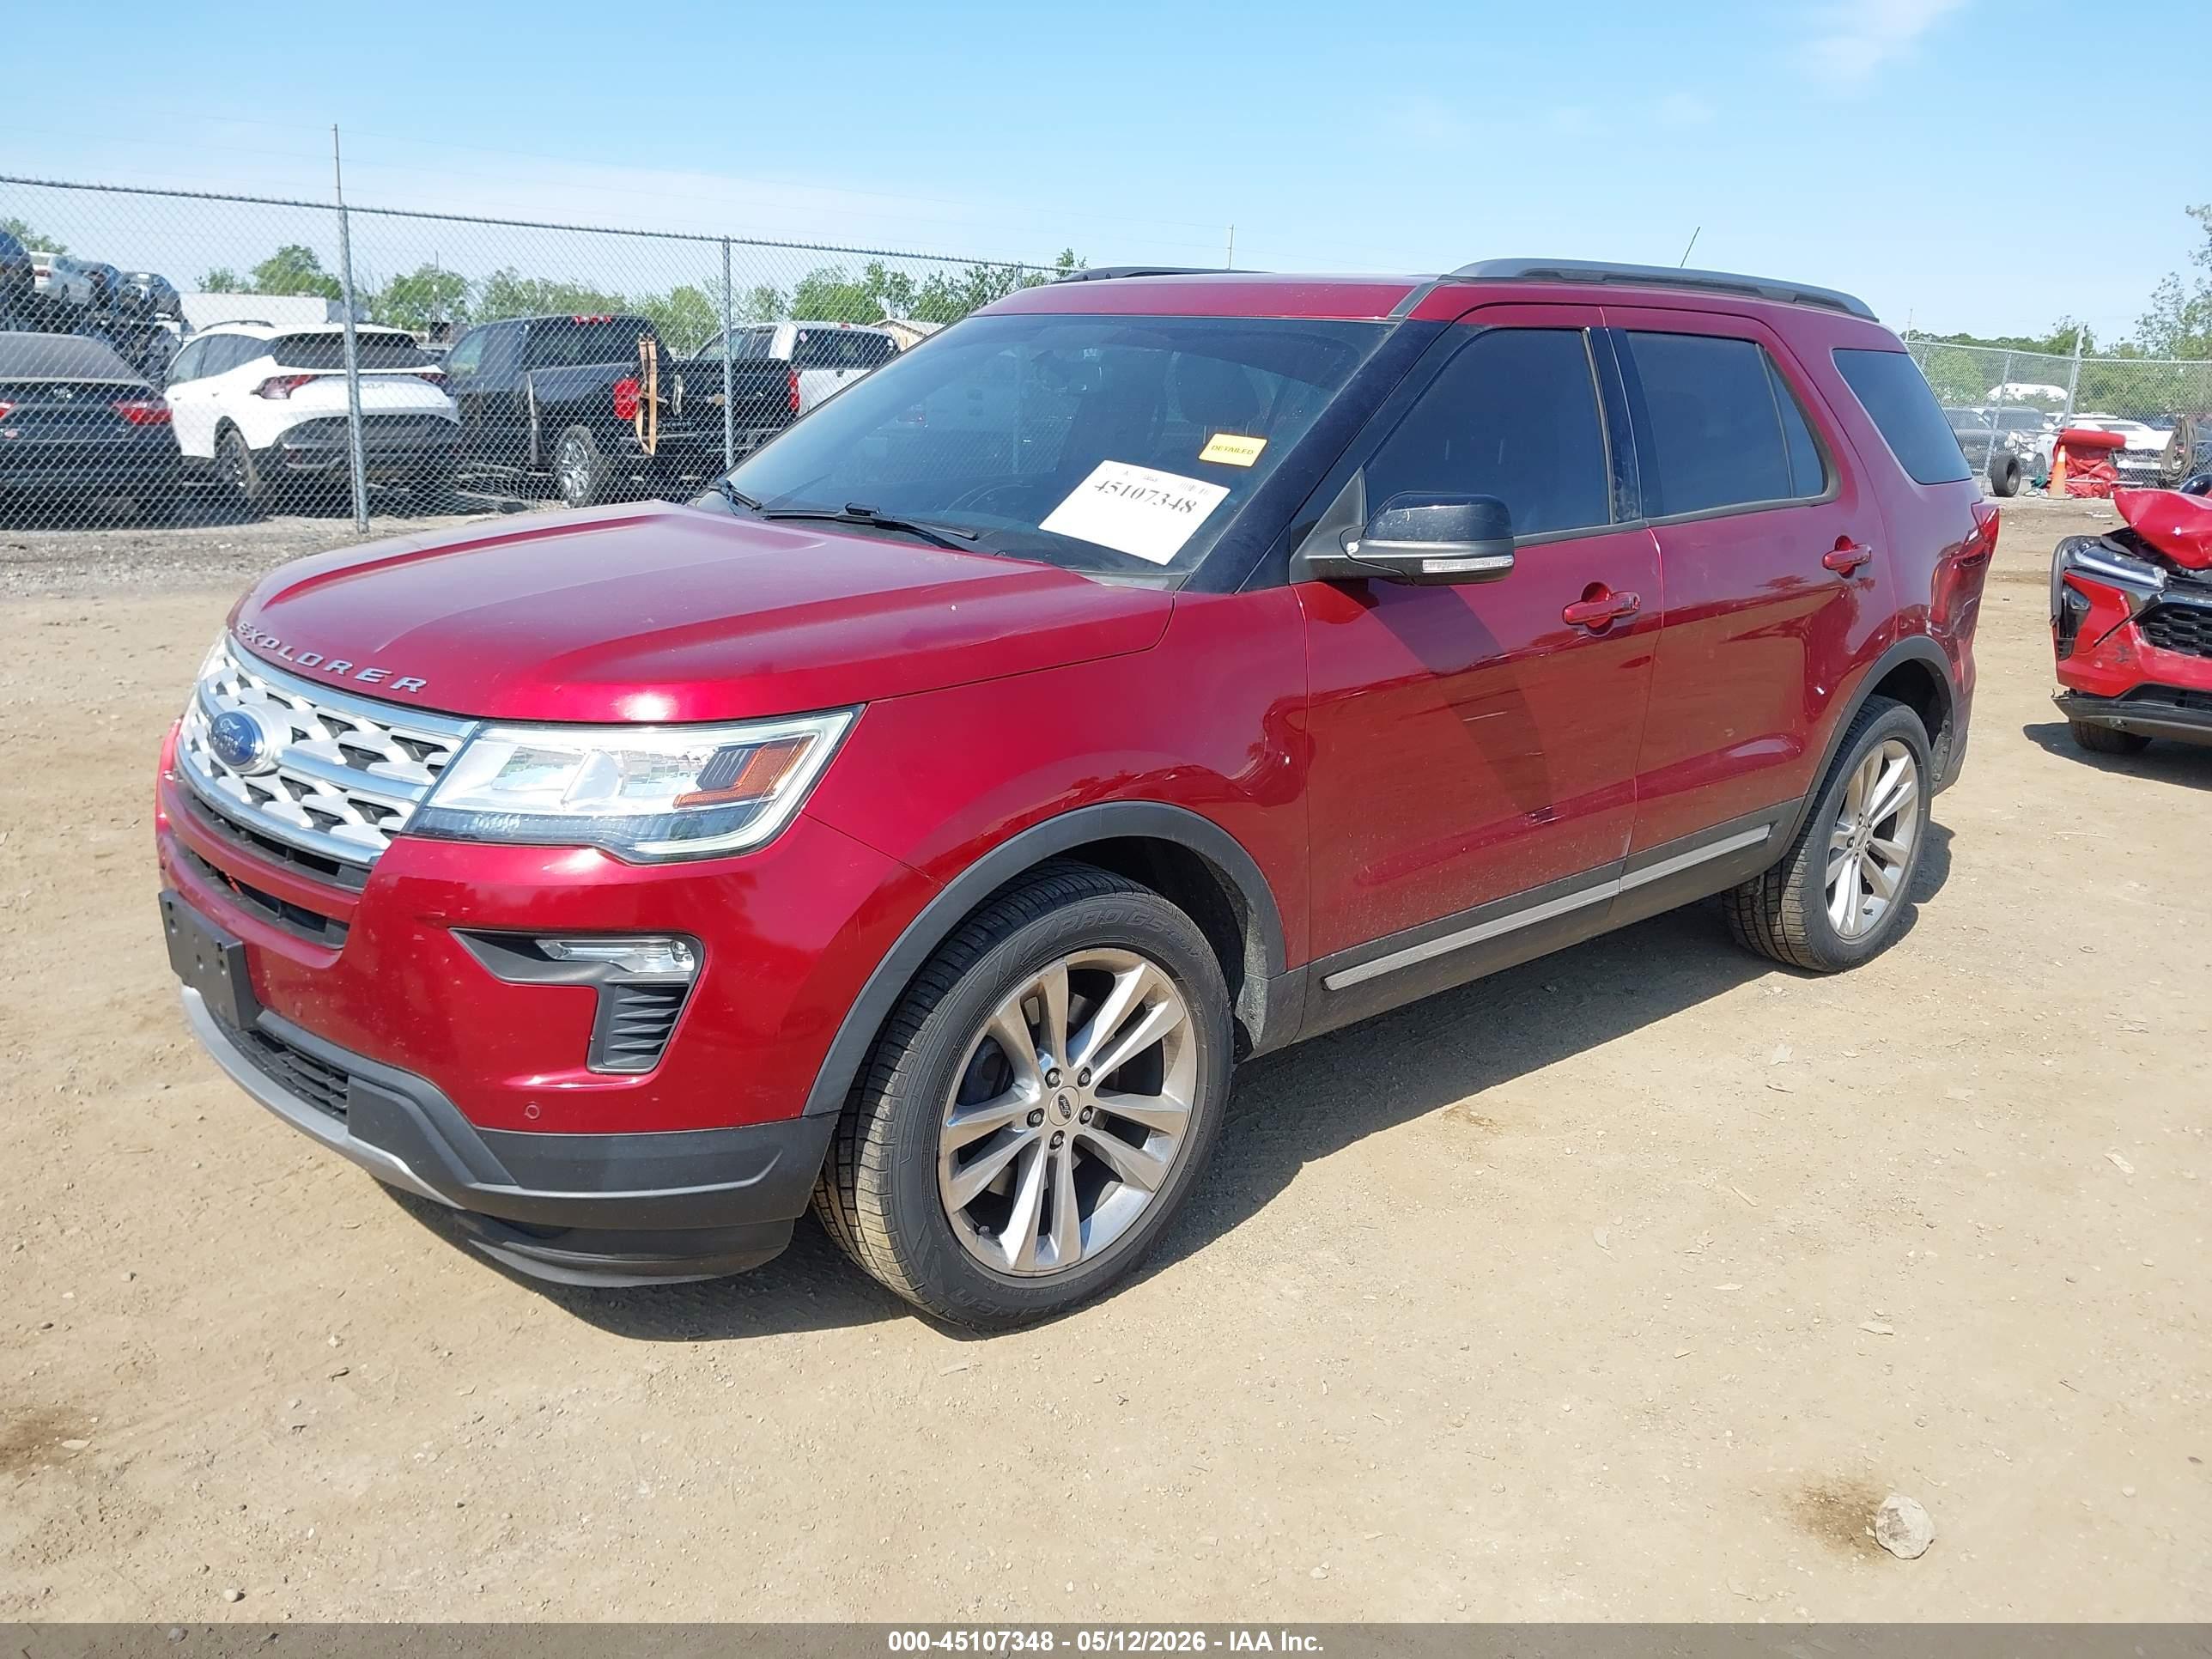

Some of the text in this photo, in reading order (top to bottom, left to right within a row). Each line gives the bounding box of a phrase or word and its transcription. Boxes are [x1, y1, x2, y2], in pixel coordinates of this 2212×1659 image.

[1211, 445, 1255, 455] DETAILED
[1094, 480, 1198, 514] 45107348
[237, 623, 427, 693] EXPLORER
